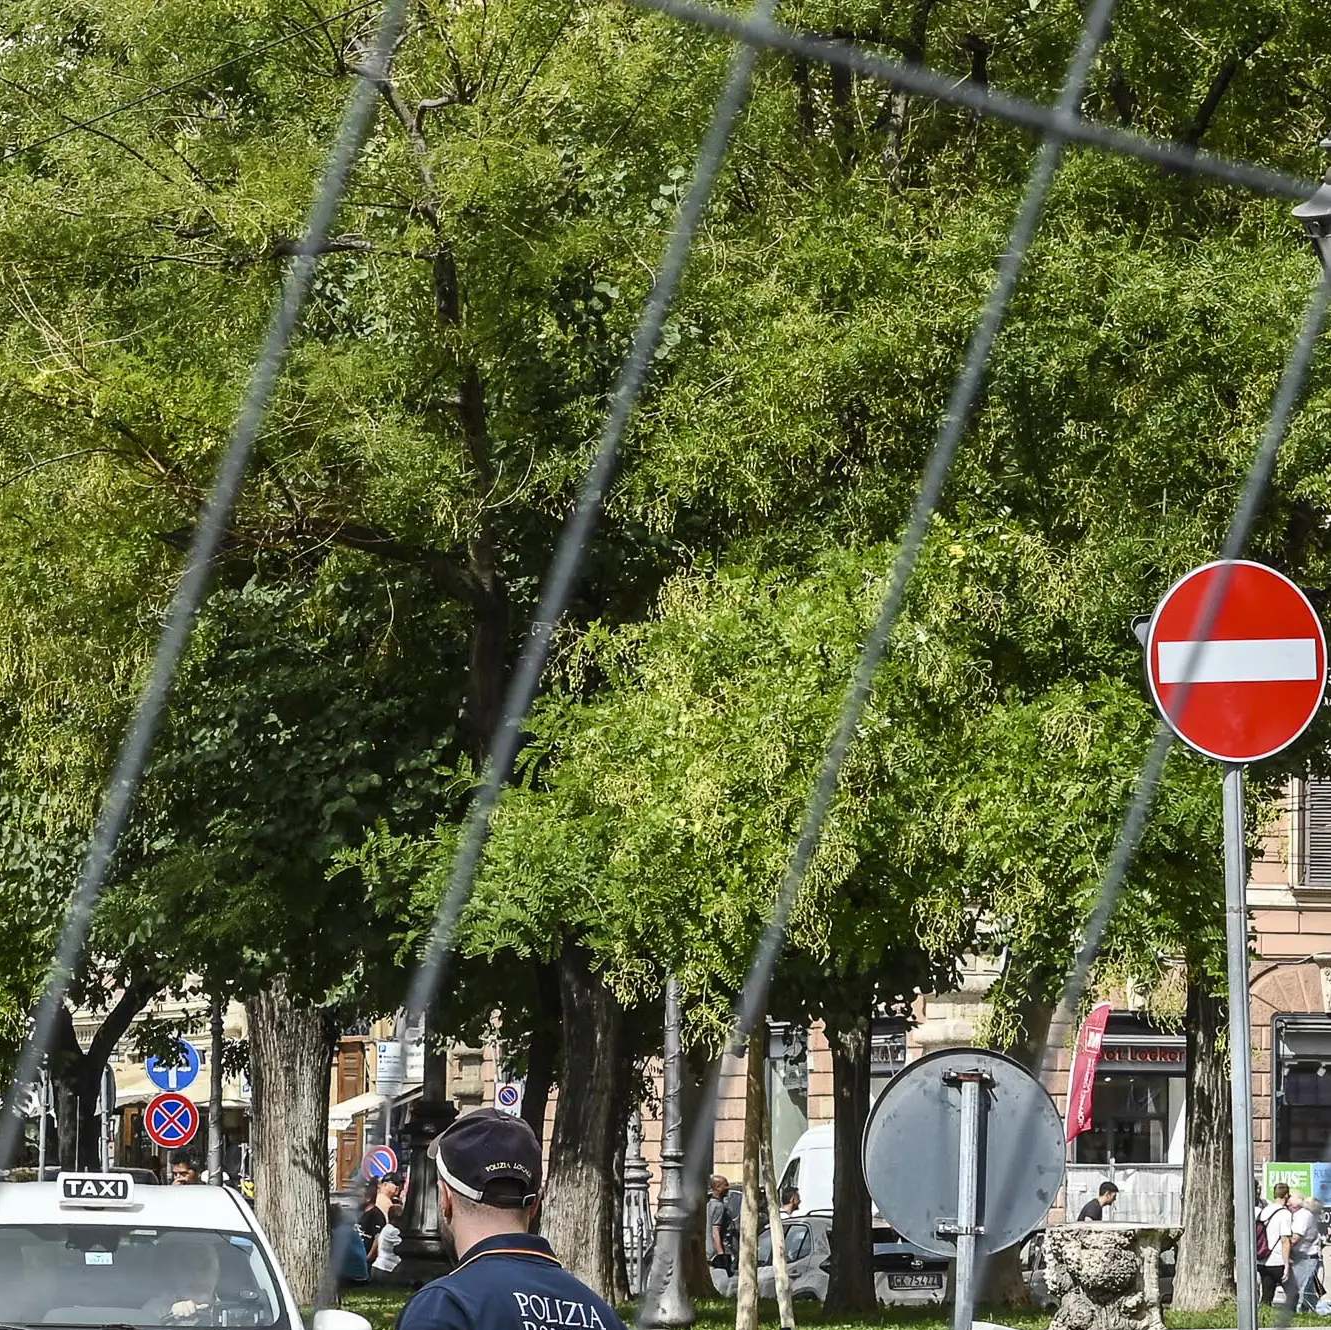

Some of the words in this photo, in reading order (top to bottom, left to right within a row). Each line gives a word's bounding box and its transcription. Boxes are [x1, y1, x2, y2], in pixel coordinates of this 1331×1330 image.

[1128, 1046, 1186, 1062] Locker
[485, 1162, 511, 1173] POLIZIA
[65, 1180, 124, 1197] TAXI
